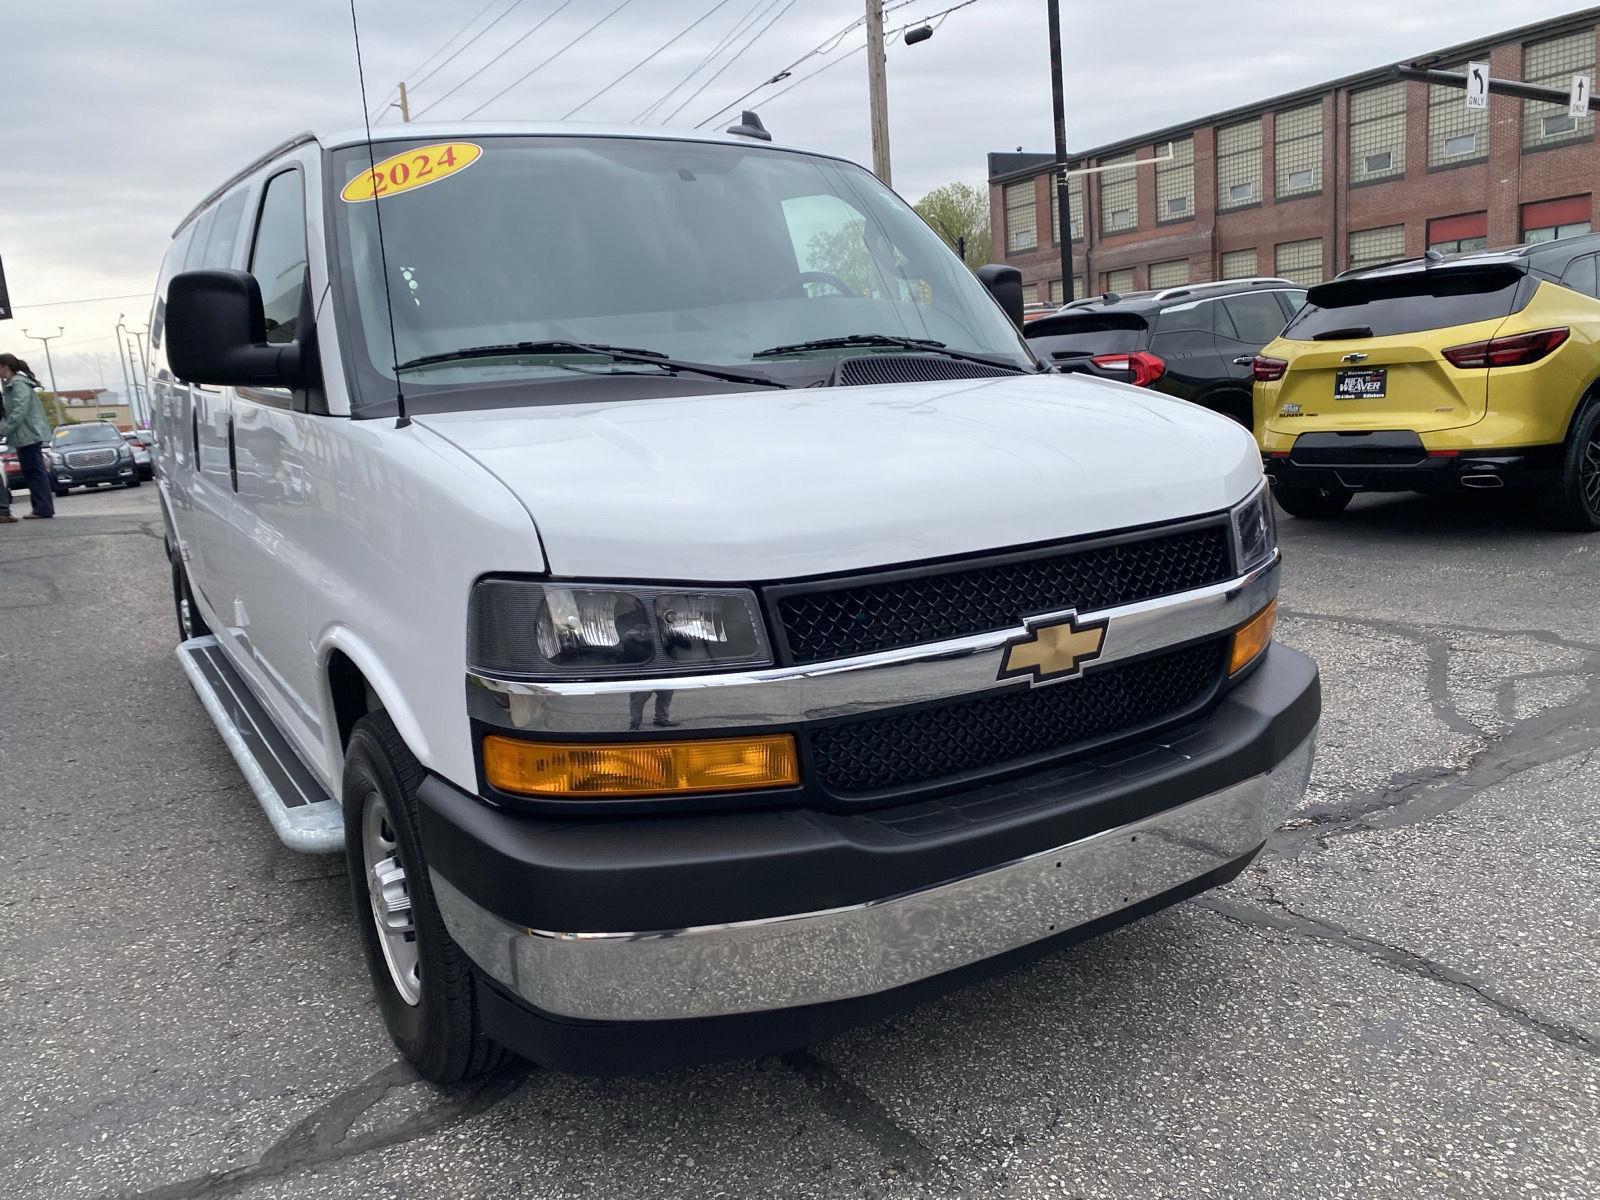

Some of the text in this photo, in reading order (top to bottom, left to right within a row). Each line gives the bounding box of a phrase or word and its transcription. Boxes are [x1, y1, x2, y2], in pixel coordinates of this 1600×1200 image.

[1468, 96, 1485, 106] ONLY
[1572, 103, 1586, 113] ONLY
[366, 146, 457, 197] 2024
[1340, 381, 1381, 391] WEAVER
[1344, 376, 1364, 386] RICK
